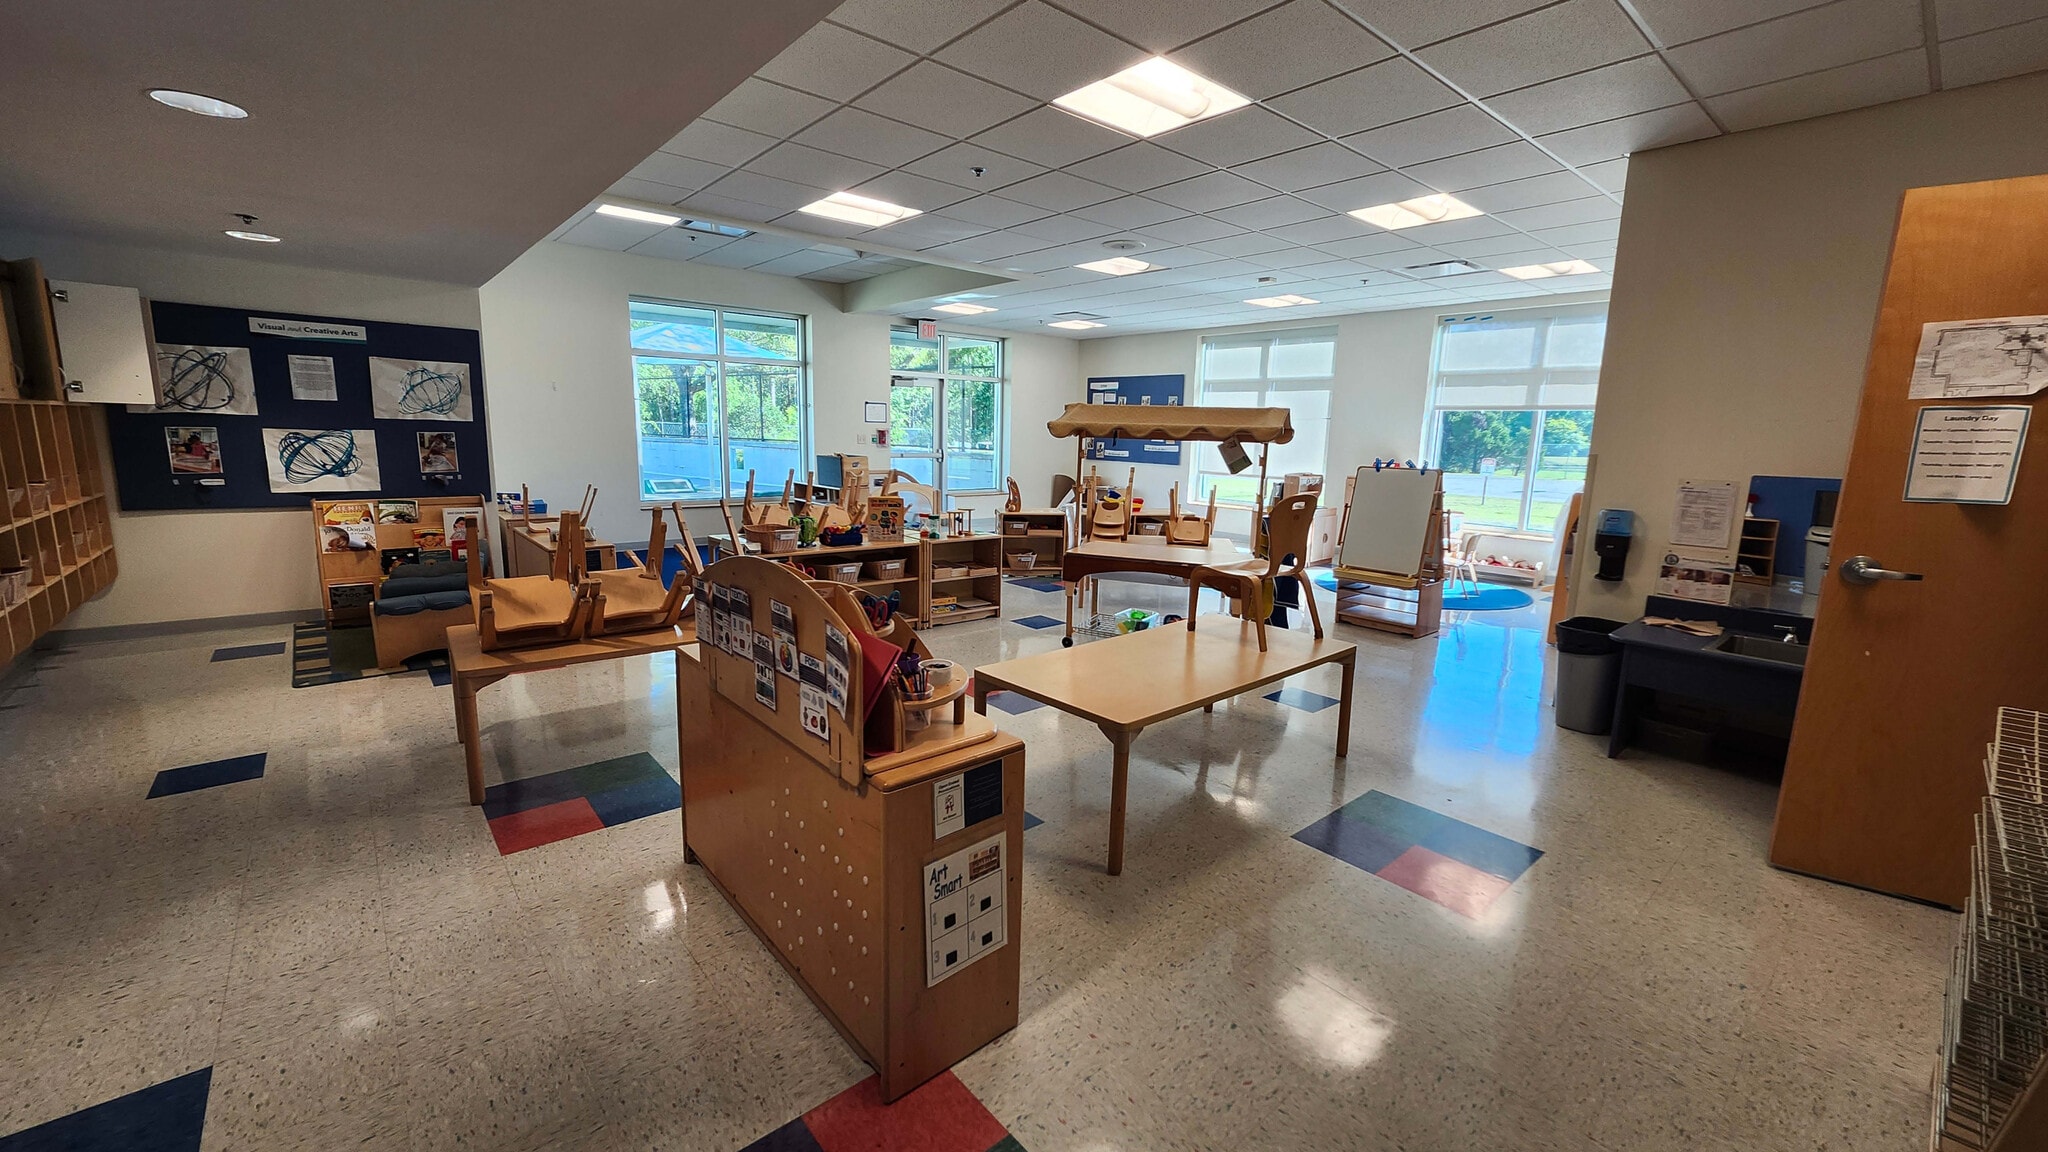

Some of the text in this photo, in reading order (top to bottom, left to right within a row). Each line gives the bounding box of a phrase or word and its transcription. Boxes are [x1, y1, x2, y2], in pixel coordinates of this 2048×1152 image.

[257, 322, 285, 331] Visual
[303, 326, 339, 336] Creative
[341, 329, 359, 337] Arts
[921, 323, 936, 338] EXIT
[804, 655, 820, 670] FORM
[929, 864, 948, 886] Art
[933, 874, 963, 900] Smart
[969, 894, 975, 907] 2
[932, 912, 937, 926] 1
[970, 930, 976, 942] 4
[933, 950, 940, 963] 3
